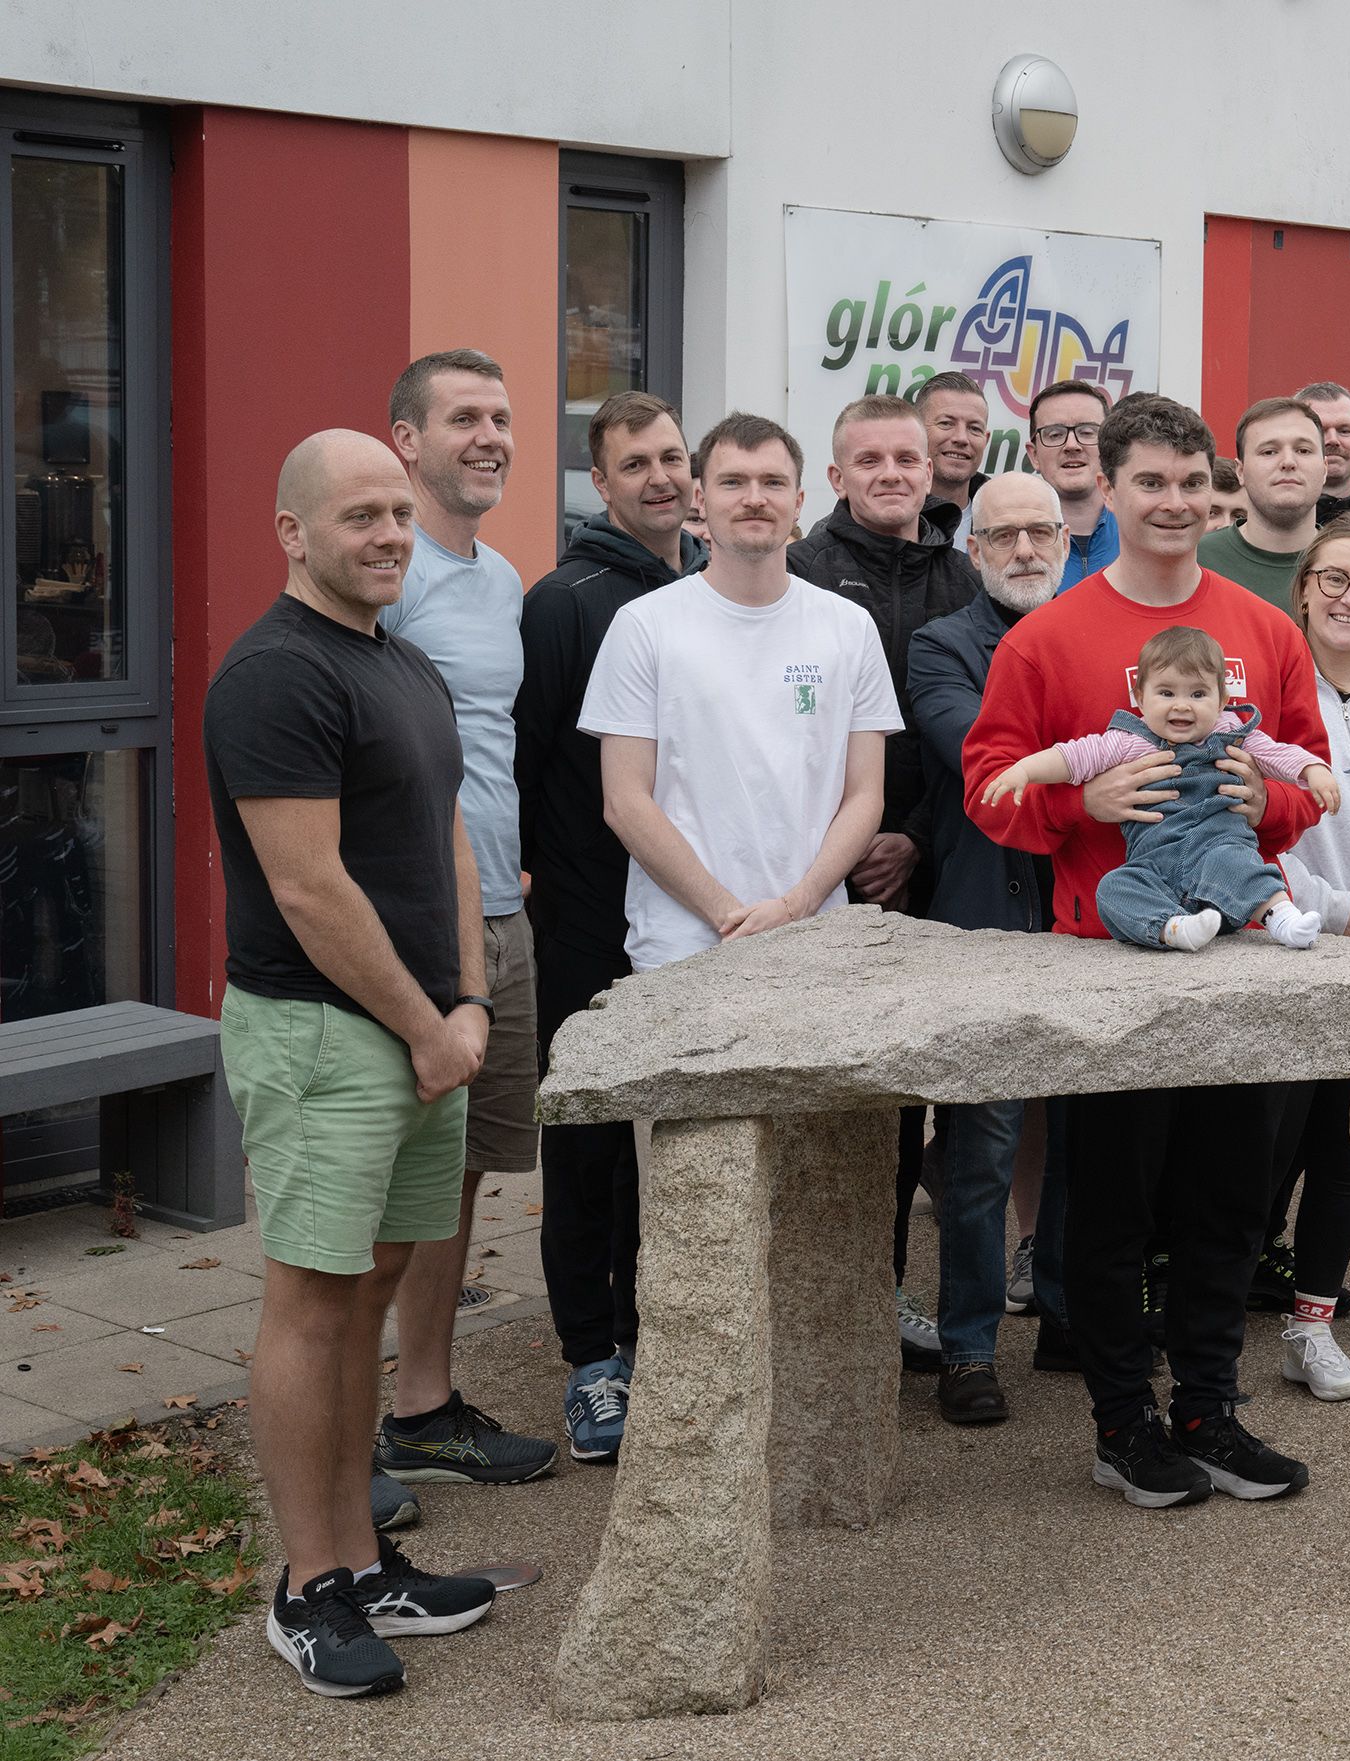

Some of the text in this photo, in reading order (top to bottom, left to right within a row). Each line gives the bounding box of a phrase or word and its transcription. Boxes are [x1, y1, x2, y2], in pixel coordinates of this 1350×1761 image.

[821, 280, 957, 370] glór
[785, 665, 820, 673] SAINT
[783, 674, 823, 684] SISTER
